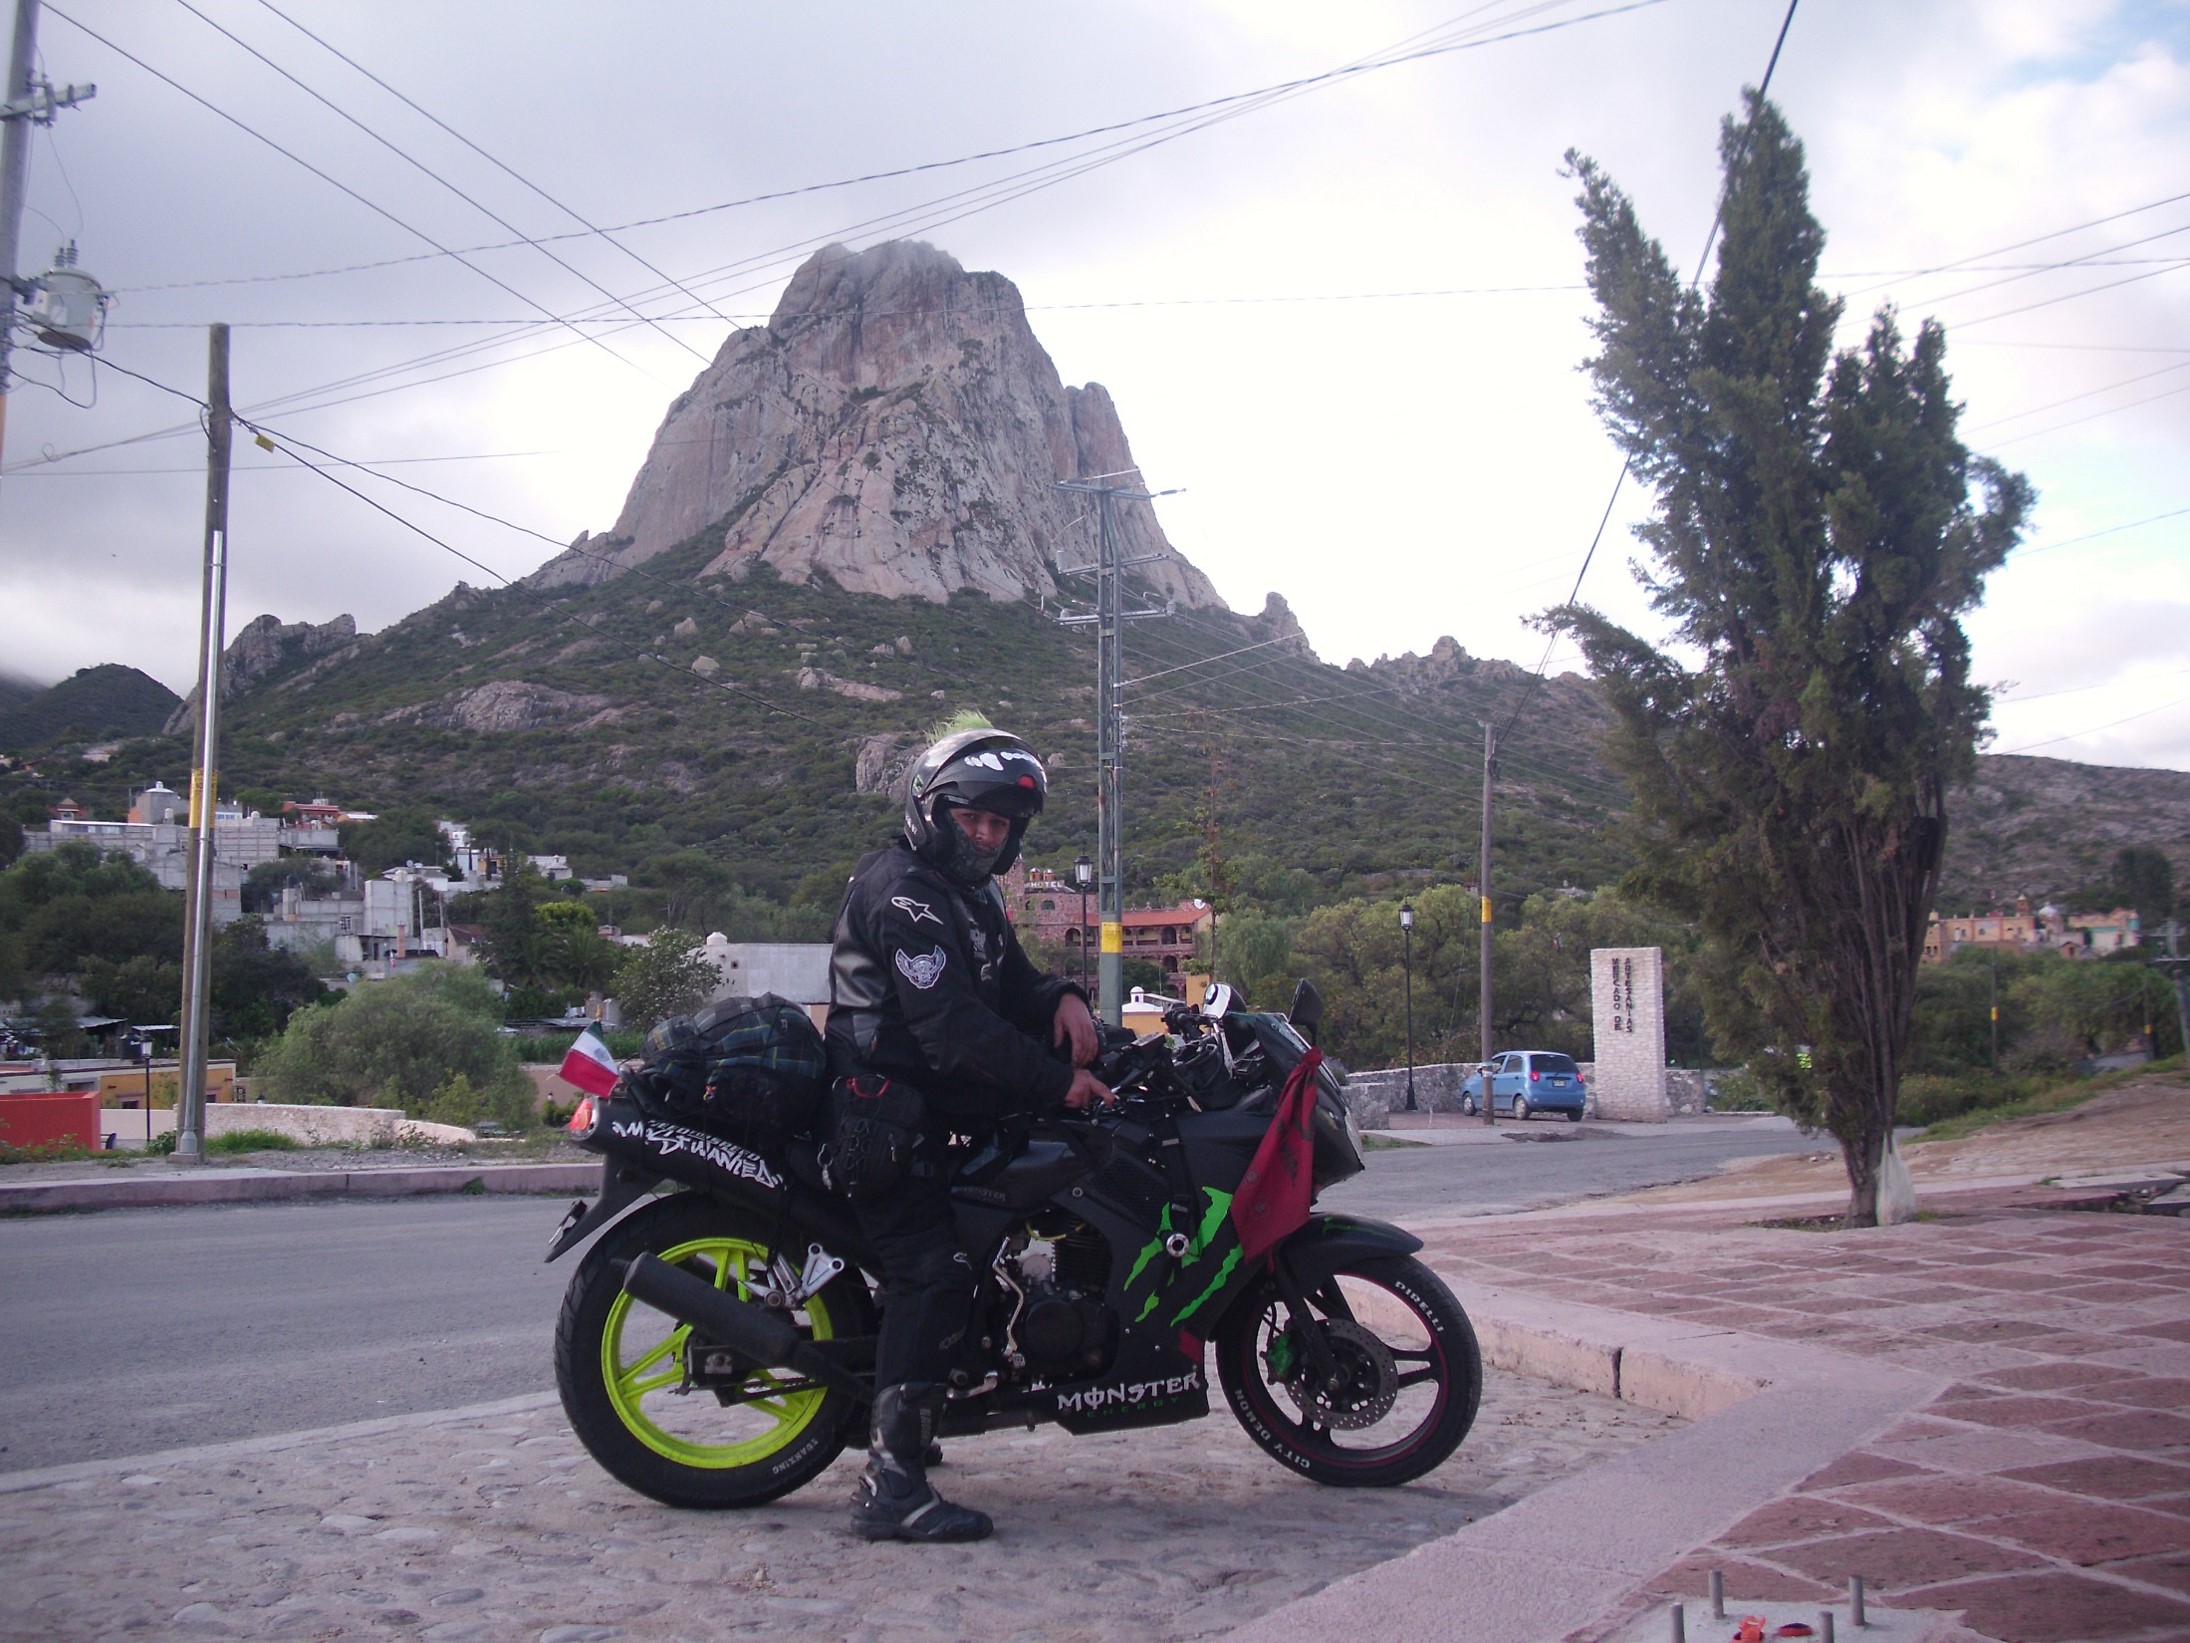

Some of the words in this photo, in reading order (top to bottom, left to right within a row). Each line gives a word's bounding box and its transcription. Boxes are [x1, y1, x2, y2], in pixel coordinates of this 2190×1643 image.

[1612, 958, 1620, 1010] MERCADO
[1614, 1015, 1622, 1031] DE
[1395, 1281, 1444, 1332] PIRELLI
[1057, 1372, 1200, 1411] MONSTER
[1086, 1396, 1179, 1418] ENERGY
[1235, 1389, 1272, 1441] DEMON
[1273, 1443, 1311, 1469] CITY
